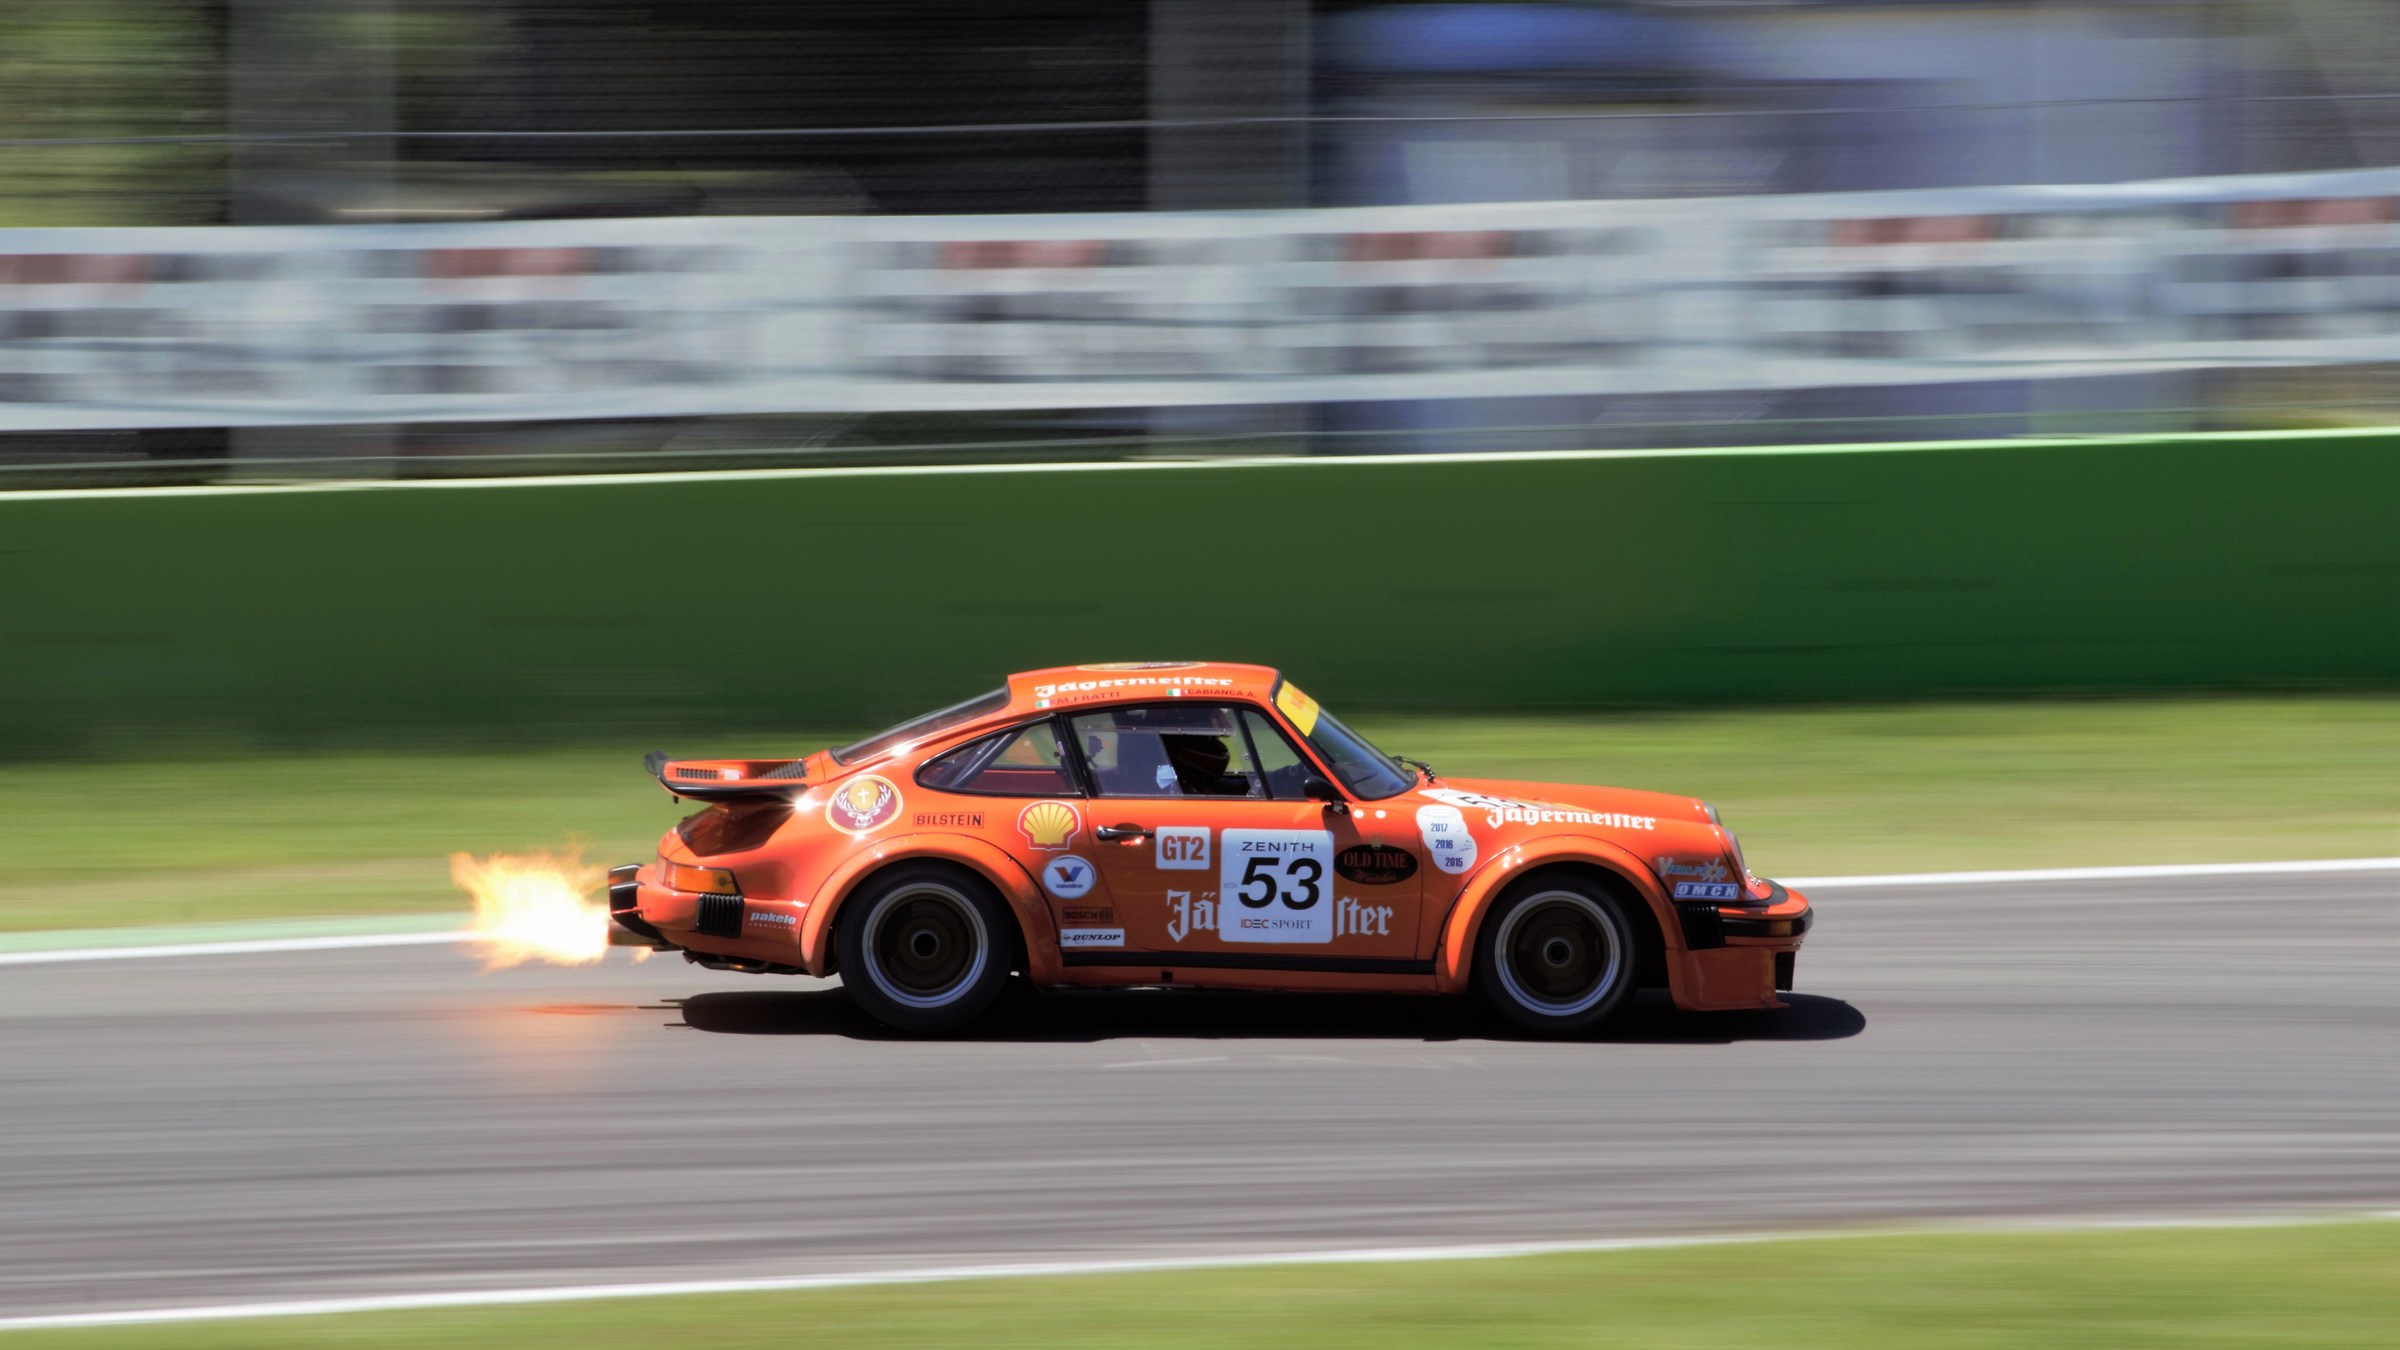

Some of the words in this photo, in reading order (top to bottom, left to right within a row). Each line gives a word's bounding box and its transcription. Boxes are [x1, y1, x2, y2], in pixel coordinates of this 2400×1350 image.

[917, 814, 981, 826] BILSTEIN
[1431, 823, 1448, 832] 2017
[1162, 835, 1204, 861] GT2
[1241, 842, 1314, 852] ZENITH
[1435, 839, 1453, 849] 2016
[1343, 851, 1371, 868] OLD
[1375, 852, 1408, 868] TIME
[1445, 857, 1463, 867] 2015
[1237, 857, 1323, 910] 53
[1678, 885, 1735, 897] OMCN
[750, 912, 797, 924] pakelo
[1064, 911, 1097, 919] BOSCH
[1240, 918, 1269, 929] IDEC
[1271, 918, 1313, 929] SPORT
